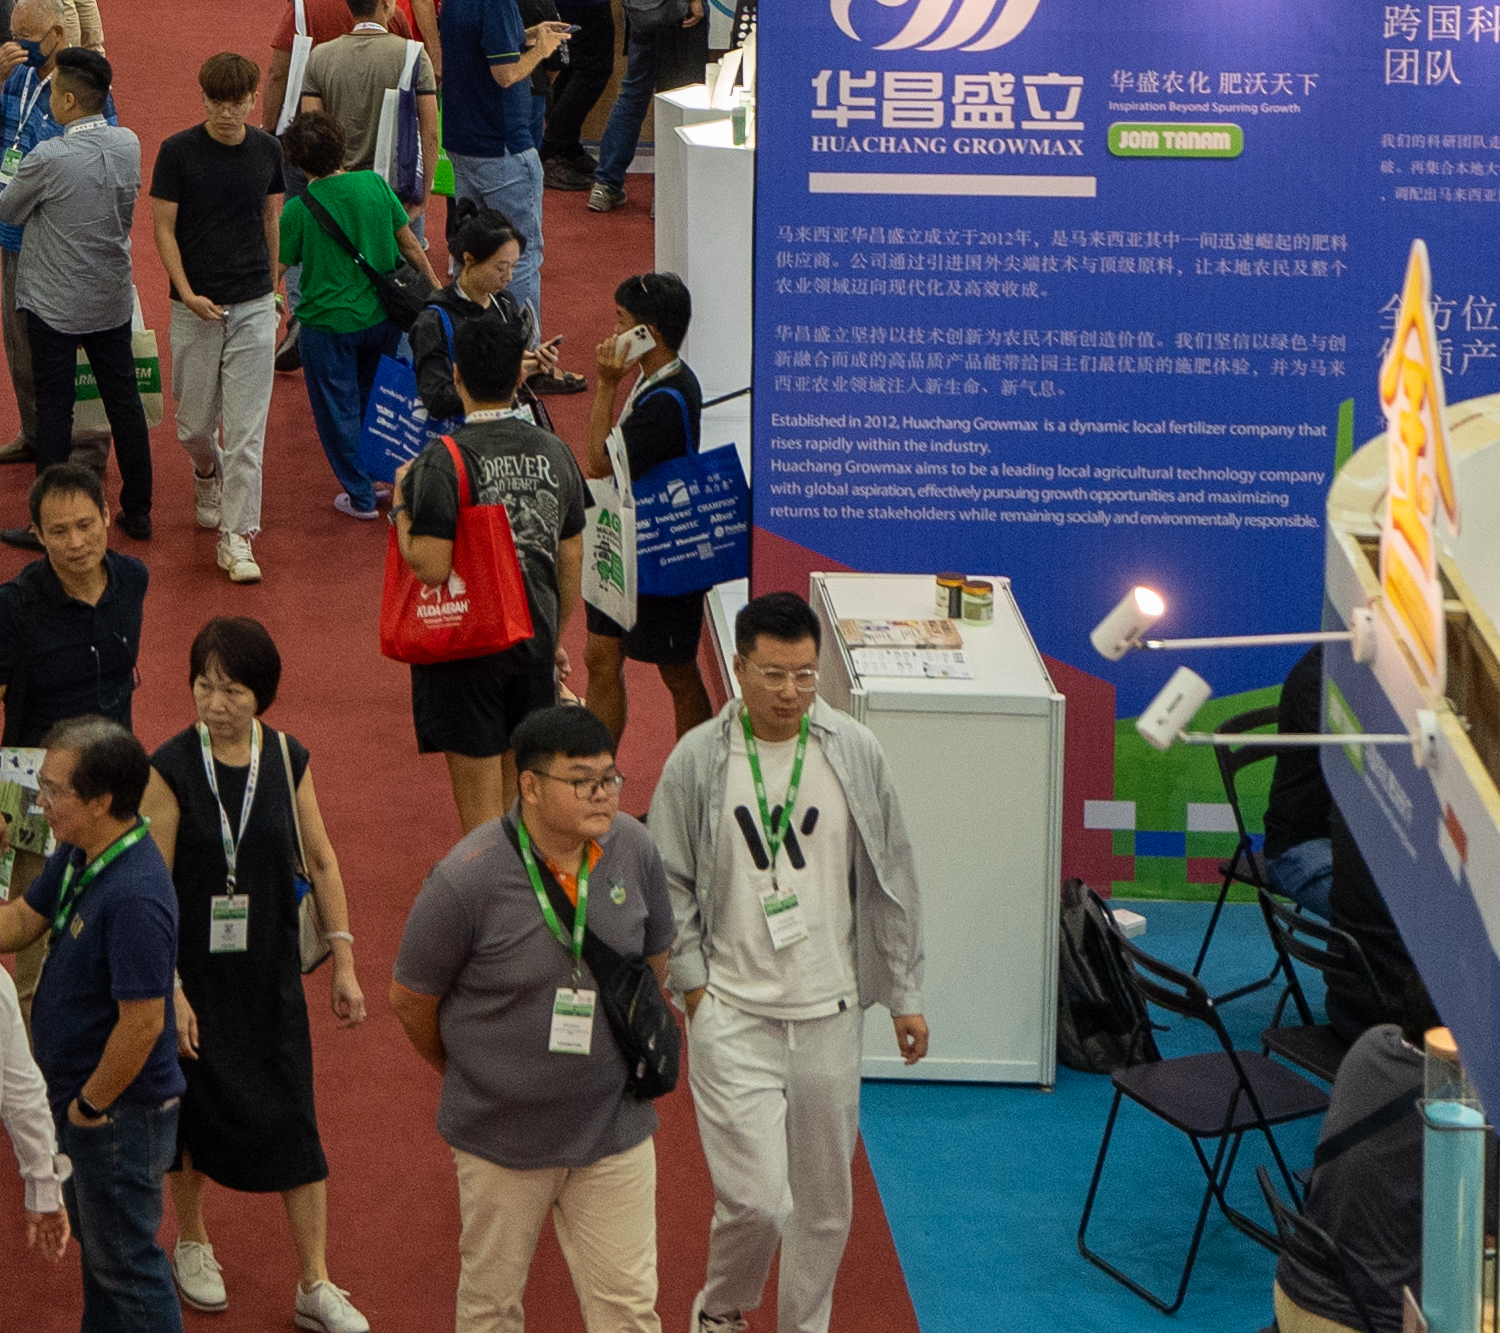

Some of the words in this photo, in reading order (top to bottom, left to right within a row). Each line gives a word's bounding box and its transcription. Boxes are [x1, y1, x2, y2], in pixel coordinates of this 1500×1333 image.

[1385, 47, 1461, 88] 团队
[1110, 69, 1211, 95] 华盛农化
[1218, 71, 1320, 97] 肥沃天下
[810, 68, 1085, 132] 华昌盛立
[1109, 100, 1166, 114] Inspiration
[1168, 101, 1209, 115] Beyond
[1211, 102, 1258, 116] Spurring
[1260, 103, 1301, 115] Growth
[811, 135, 947, 155] HUACHANG
[953, 137, 1085, 157] GROWMAX
[1118, 130, 1159, 150] JOM
[771, 413, 846, 429] Established
[849, 414, 862, 428] in
[902, 416, 971, 433] Huachang
[973, 417, 1039, 432] Growmax
[1043, 419, 1055, 432] is
[1058, 421, 1067, 432] a
[1069, 419, 1130, 435] dynamic
[1132, 420, 1167, 433] local
[1169, 420, 1227, 435] fertilizer
[1229, 424, 1296, 439] company
[1299, 423, 1328, 437] that
[770, 437, 802, 450] rises
[805, 437, 854, 454] rapidly
[856, 438, 901, 452] within
[904, 439, 927, 452] the
[930, 439, 992, 456] industry.
